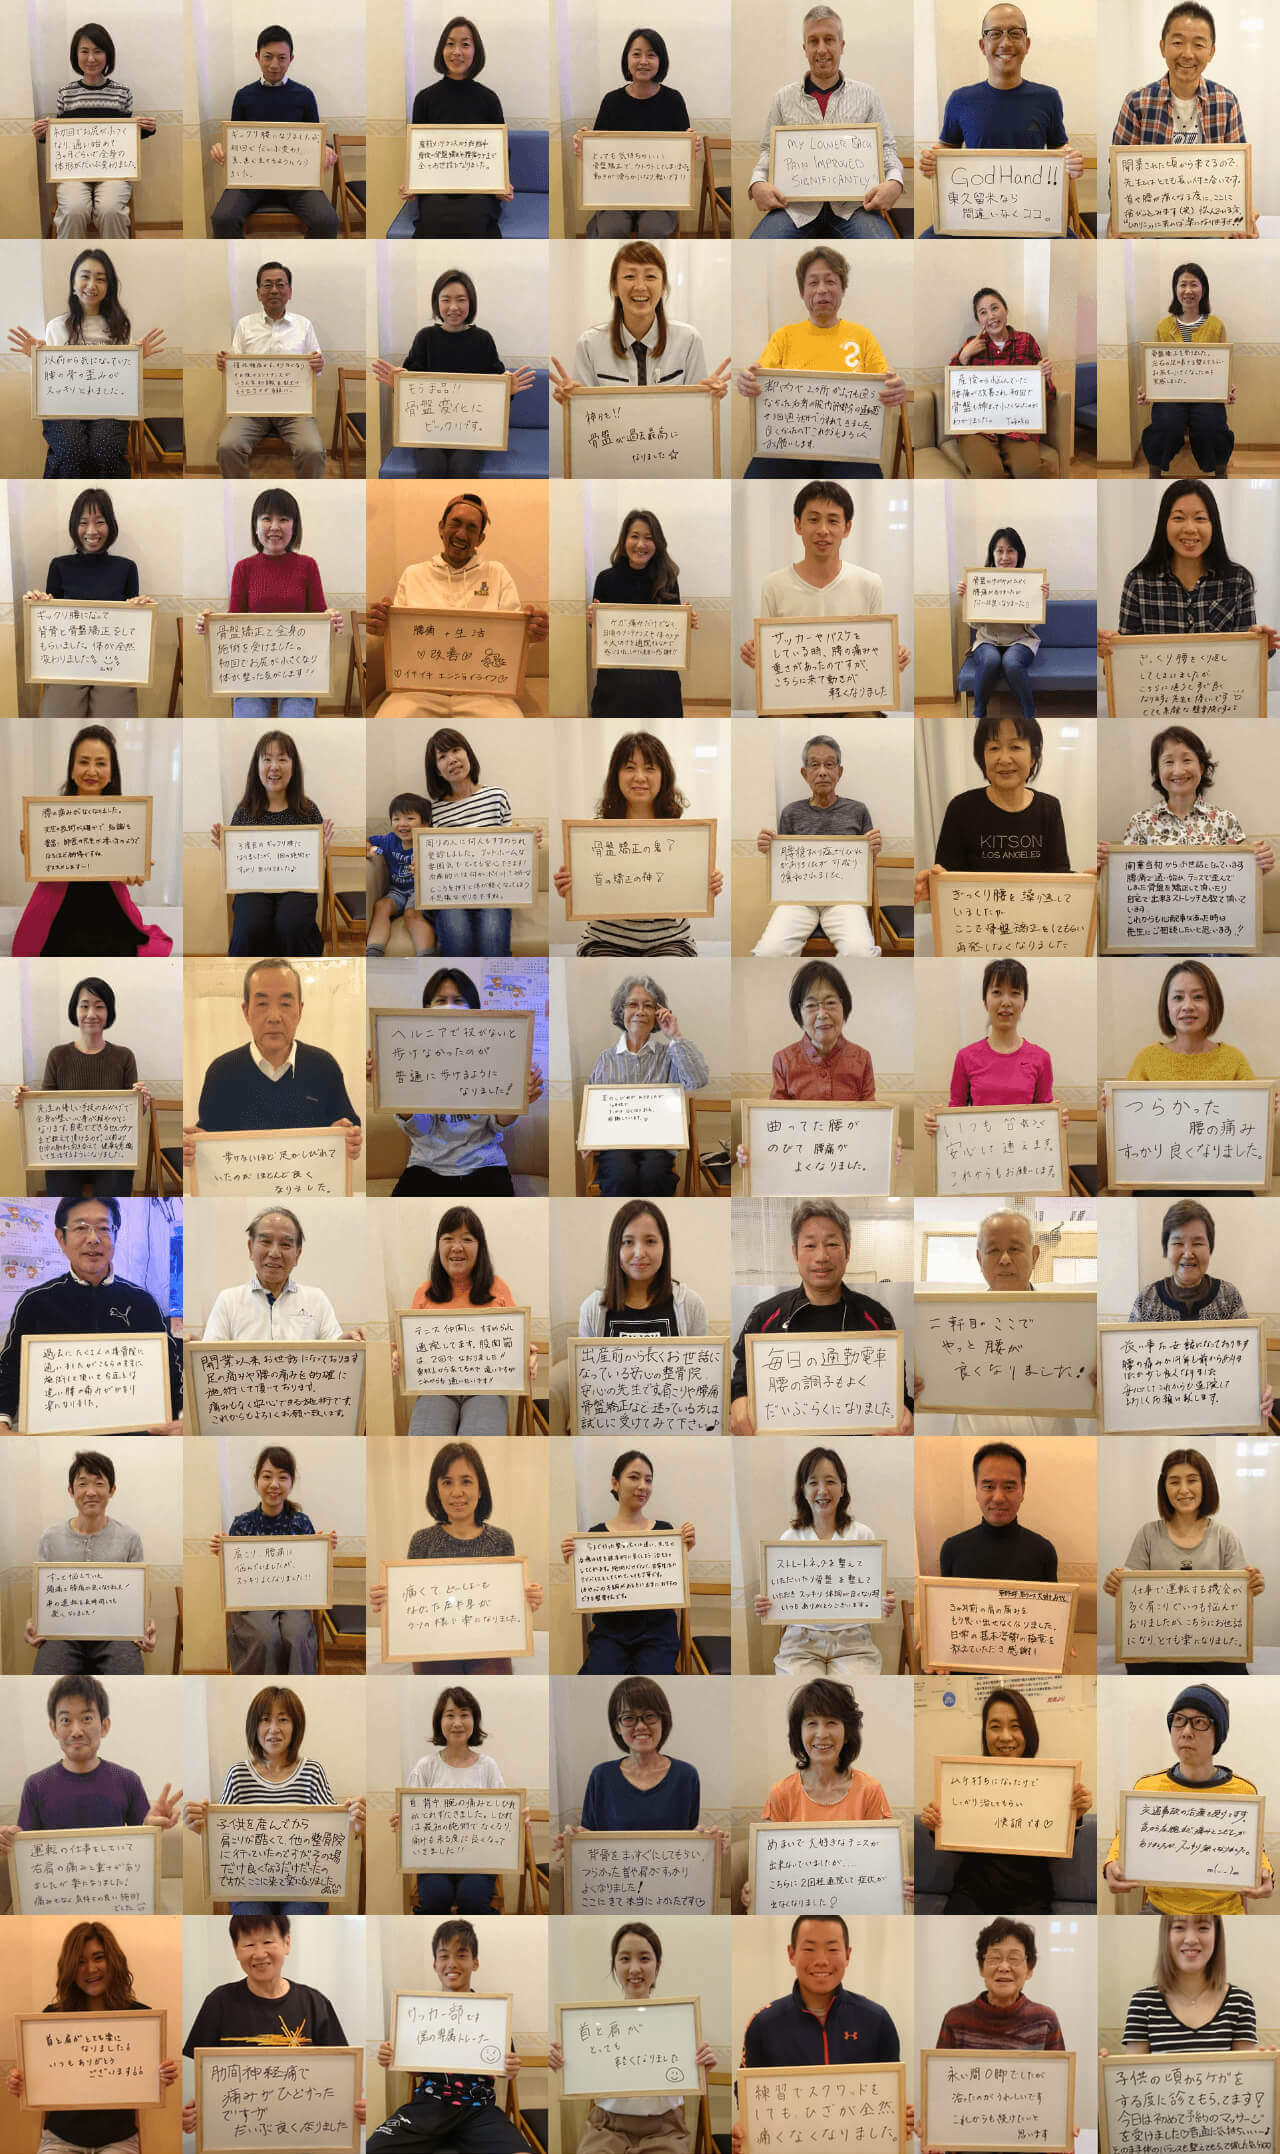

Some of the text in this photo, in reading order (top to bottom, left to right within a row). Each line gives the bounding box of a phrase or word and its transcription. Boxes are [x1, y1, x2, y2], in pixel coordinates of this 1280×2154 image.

[951, 165, 1058, 187] God Hand!!
[948, 192, 1019, 205] 東久留米なら
[980, 834, 1043, 849] KITSON
[982, 850, 1041, 859] LOS ANGELES
